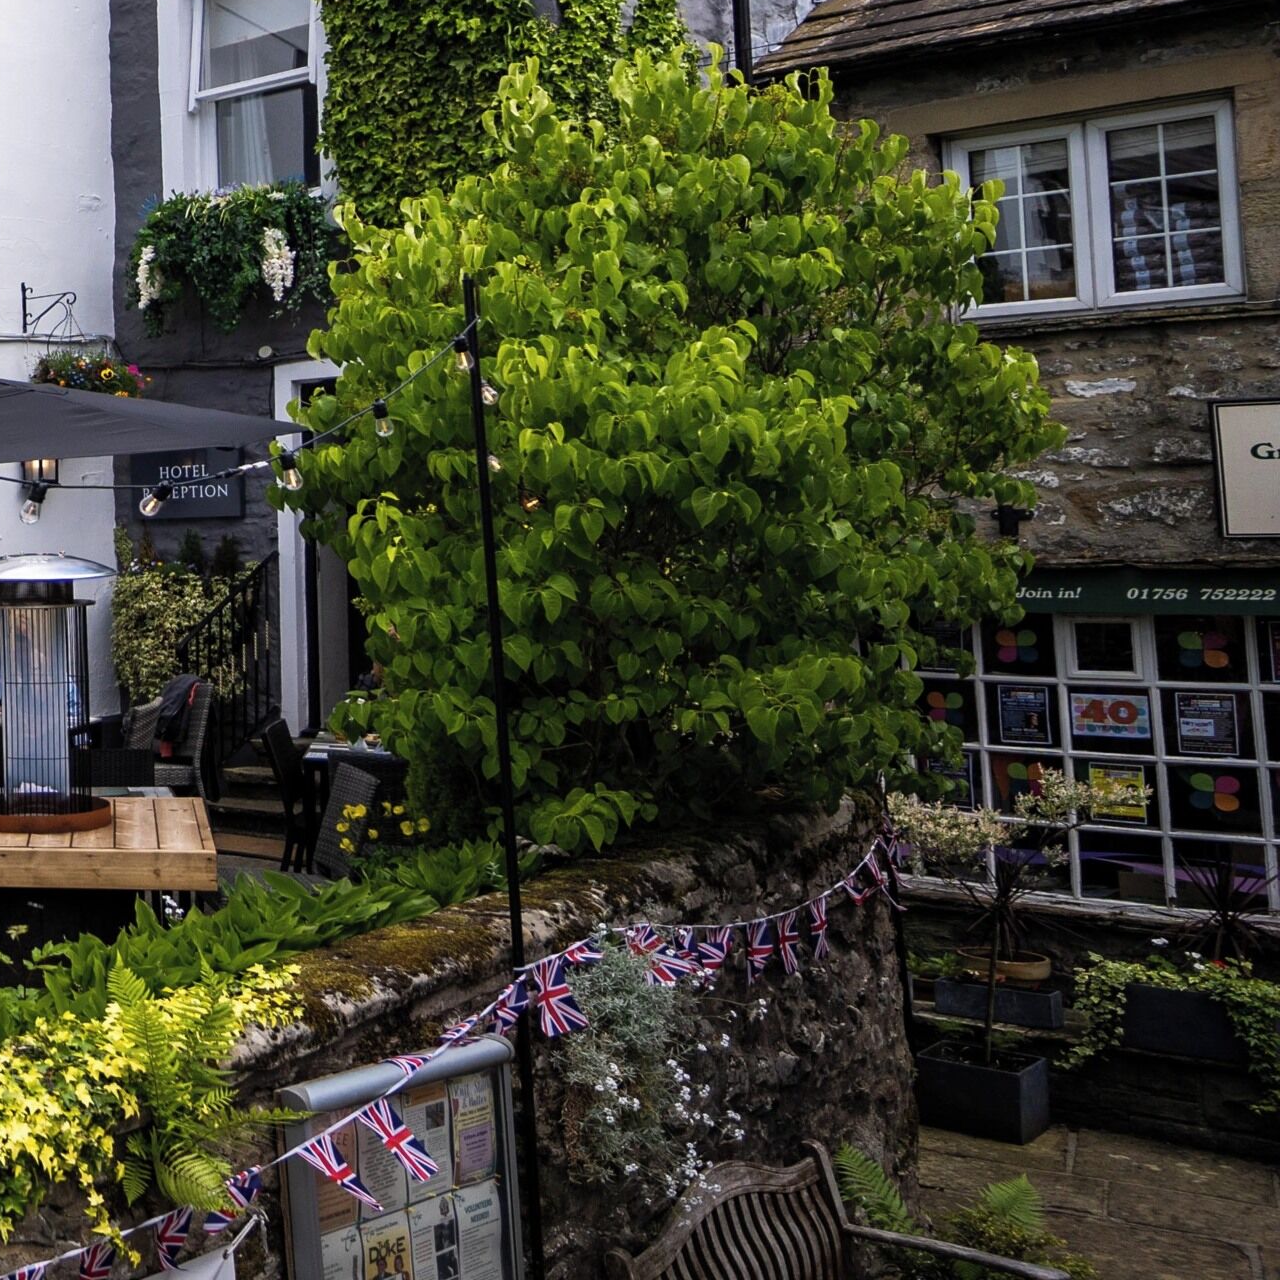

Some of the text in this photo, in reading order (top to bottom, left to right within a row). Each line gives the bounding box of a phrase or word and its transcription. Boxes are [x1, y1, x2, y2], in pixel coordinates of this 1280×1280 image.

[159, 463, 209, 480] HOTEL
[143, 483, 229, 500] REPTION
[1015, 587, 1277, 601] Join in! 01756 752222
[1080, 699, 1139, 725] 40
[369, 1236, 406, 1264] DUKE
